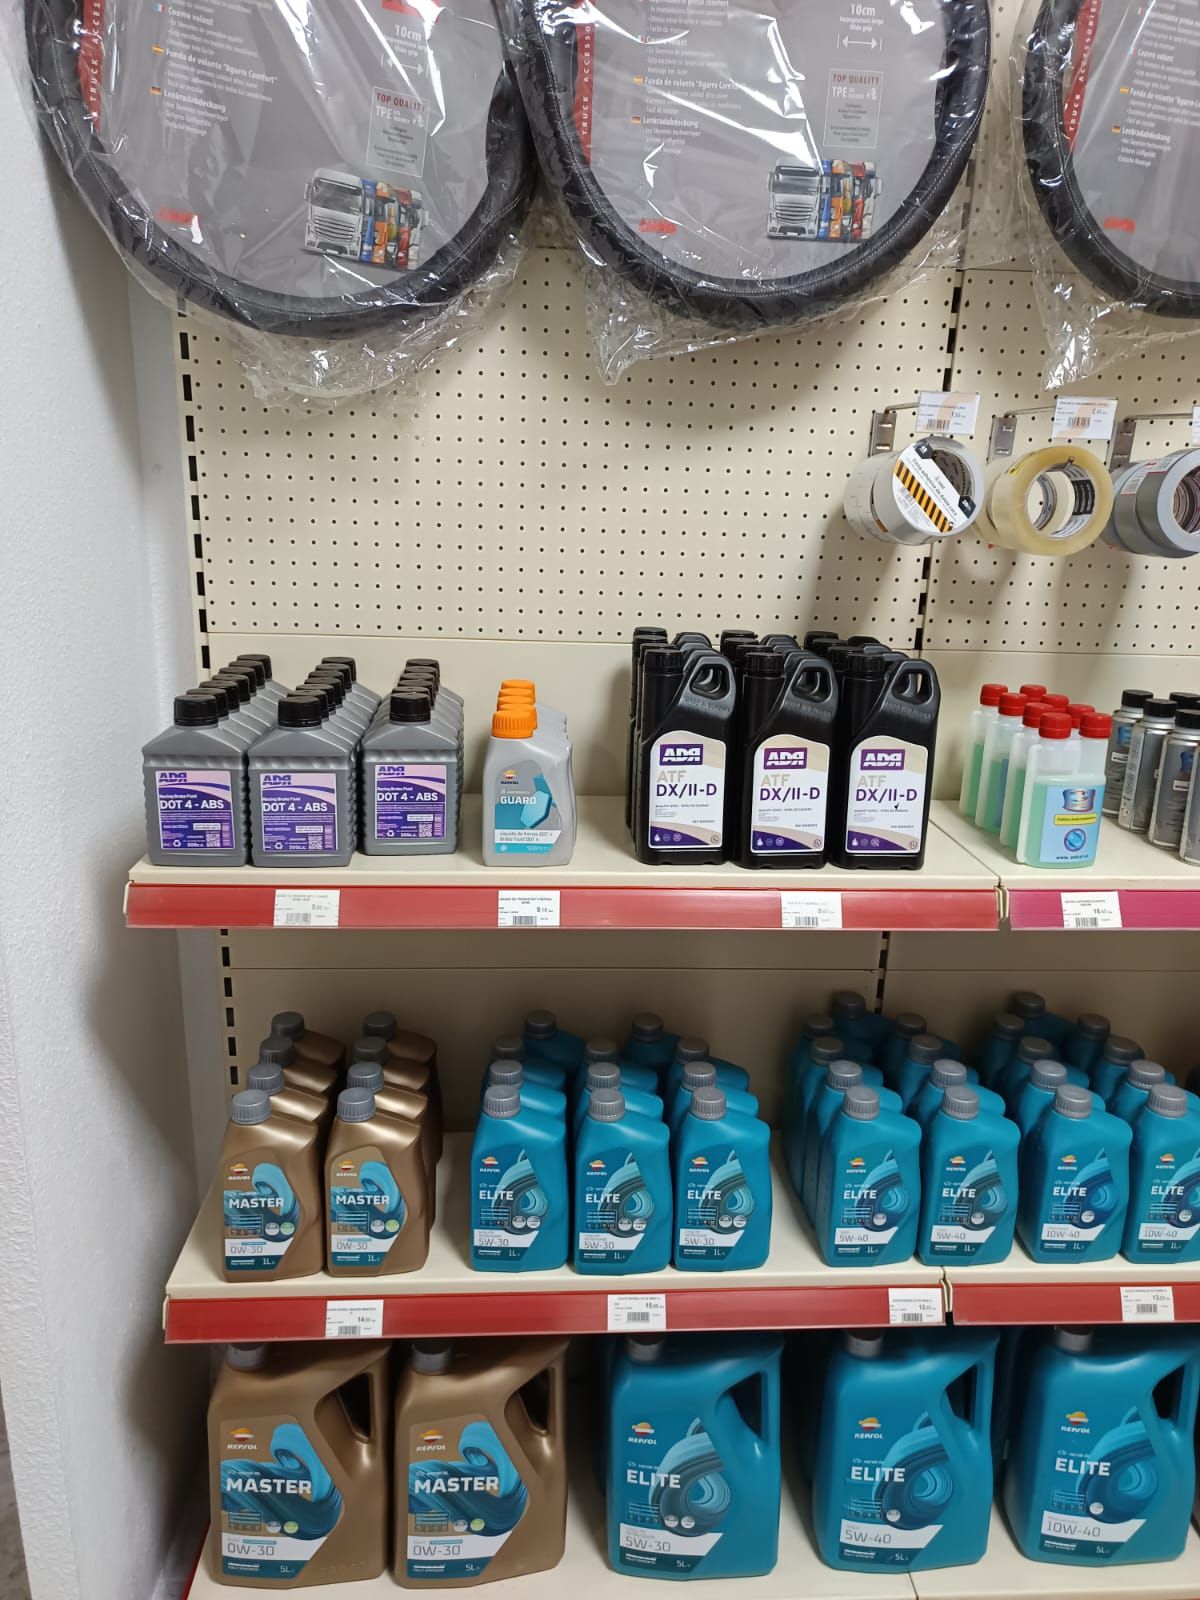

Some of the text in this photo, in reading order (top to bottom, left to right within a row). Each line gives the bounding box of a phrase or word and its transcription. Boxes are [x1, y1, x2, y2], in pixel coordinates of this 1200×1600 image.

[850, 3, 876, 17] 10cm
[168, 6, 213, 26] Couvre volant
[395, 24, 422, 42] 10cm
[583, 25, 591, 83] ACCESSO
[189, 54, 200, 64] de
[200, 56, 222, 69] volante
[89, 58, 99, 102] TRUCK
[644, 76, 663, 86] Funda
[663, 78, 672, 87] de
[672, 78, 695, 88] volante
[832, 73, 880, 85] TOP QUALITY
[375, 92, 392, 103] TOP
[832, 86, 848, 98] TPE
[375, 105, 392, 120] TPE
[1068, 93, 1081, 132] TRUCK
[642, 116, 699, 129] Lenkradabdeckung
[657, 770, 687, 783] ATF
[761, 774, 791, 787] ATF
[857, 775, 887, 788] ATF
[656, 783, 717, 799] DX/II-D
[760, 787, 821, 803] DX/II-D
[856, 788, 918, 803] DX/II-D
[377, 792, 399, 802] DOT
[400, 792, 409, 801] 4
[416, 792, 438, 801] ABS
[500, 795, 537, 805] GUARD
[160, 800, 183, 810] DOT
[185, 800, 192, 809] 4
[200, 800, 225, 809] ABS
[263, 802, 286, 812] DOT
[287, 803, 296, 811] 4
[304, 802, 328, 811] ABS
[479, 1190, 514, 1201] ELITE
[687, 1190, 722, 1201] ELITE
[843, 1189, 878, 1200] ELITE
[942, 1187, 977, 1198] ELITE
[1052, 1186, 1088, 1197] ELITE
[1150, 1185, 1185, 1196] ELITE
[228, 1197, 285, 1209] MASTER
[335, 1195, 391, 1205] MASTER
[585, 1193, 621, 1204] ELITE
[839, 1233, 869, 1242] 5W-40
[936, 1231, 966, 1241] 5W-40
[1046, 1229, 1080, 1239] 10W-40
[1143, 1229, 1178, 1238] 10W-40
[336, 1241, 368, 1250] 0W-30
[478, 1237, 509, 1247] 5W-30
[583, 1240, 615, 1250] 5W-30
[684, 1237, 715, 1246] 5W-30
[230, 1246, 264, 1254] 0W-30
[1060, 1425, 1091, 1434] REPSOL
[628, 1437, 657, 1445] REPSOL
[416, 1444, 447, 1452] REPSOL
[1055, 1456, 1111, 1477] ELITE
[626, 1469, 681, 1489] ELITE
[850, 1466, 906, 1483] ELITE
[226, 1478, 312, 1494] MASTER
[414, 1476, 499, 1494] MASTER
[1046, 1519, 1101, 1538] 10W-40
[844, 1529, 892, 1544] 5W-40
[227, 1542, 275, 1556] 0W-30
[625, 1536, 671, 1552] 5W-30
[1095, 1545, 1106, 1554] 5L
[413, 1544, 461, 1556] 0W-30
[895, 1552, 905, 1561] 5L
[280, 1564, 291, 1573] 5L
[465, 1563, 476, 1572] 5L
[676, 1560, 687, 1568] 5L
